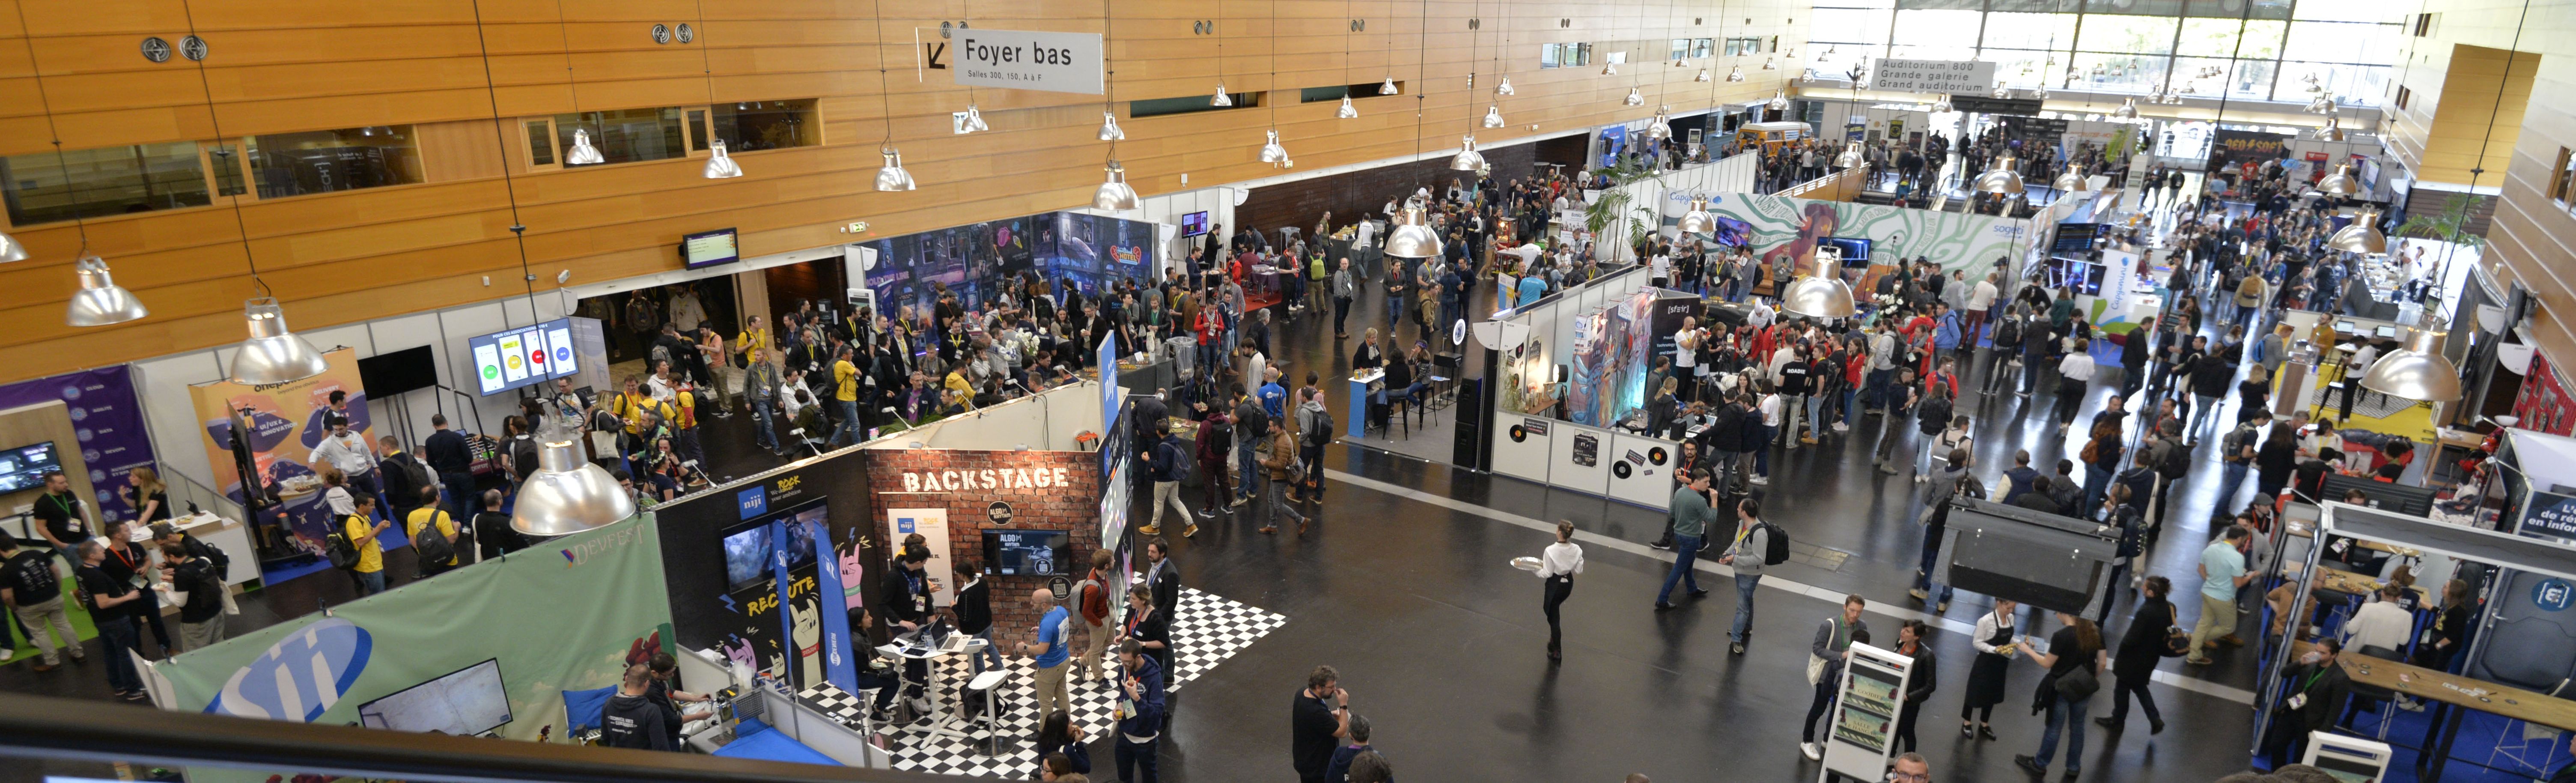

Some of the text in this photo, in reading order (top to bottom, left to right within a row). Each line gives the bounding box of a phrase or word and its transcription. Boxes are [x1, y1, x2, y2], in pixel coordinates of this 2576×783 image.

[966, 39, 1072, 66] Foyer bas
[1882, 60, 1945, 70] Auditorium
[990, 71, 1004, 80] 300,
[1007, 73, 1021, 81] 150,
[1881, 70, 1968, 81] Grande galerie
[1879, 80, 1982, 91] Grand auditorium
[1993, 224, 2024, 235] sogeti
[1048, 257, 1070, 266] PROUD
[896, 272, 909, 281] LINE
[2111, 266, 2128, 310] Capgemini
[510, 326, 537, 335] ASSOCIATIONS
[302, 380, 319, 389] obvious
[1105, 356, 1116, 402] niji
[313, 385, 339, 395] DELIVERY
[259, 420, 278, 430] UI/UX
[261, 422, 298, 437] INNOVATION
[777, 475, 801, 489] ROCK
[903, 467, 1069, 492] BACKSTAGE
[782, 489, 801, 498] ambition
[744, 494, 762, 509] niji
[2540, 510, 2557, 520] de
[2528, 518, 2544, 526] en
[574, 524, 644, 566] DEVFEST
[747, 576, 815, 617] RECUTE
[1857, 688, 1883, 701] GOODIES
[1852, 724, 1876, 736] HANGAR
[1853, 720, 1870, 729] SALLE
